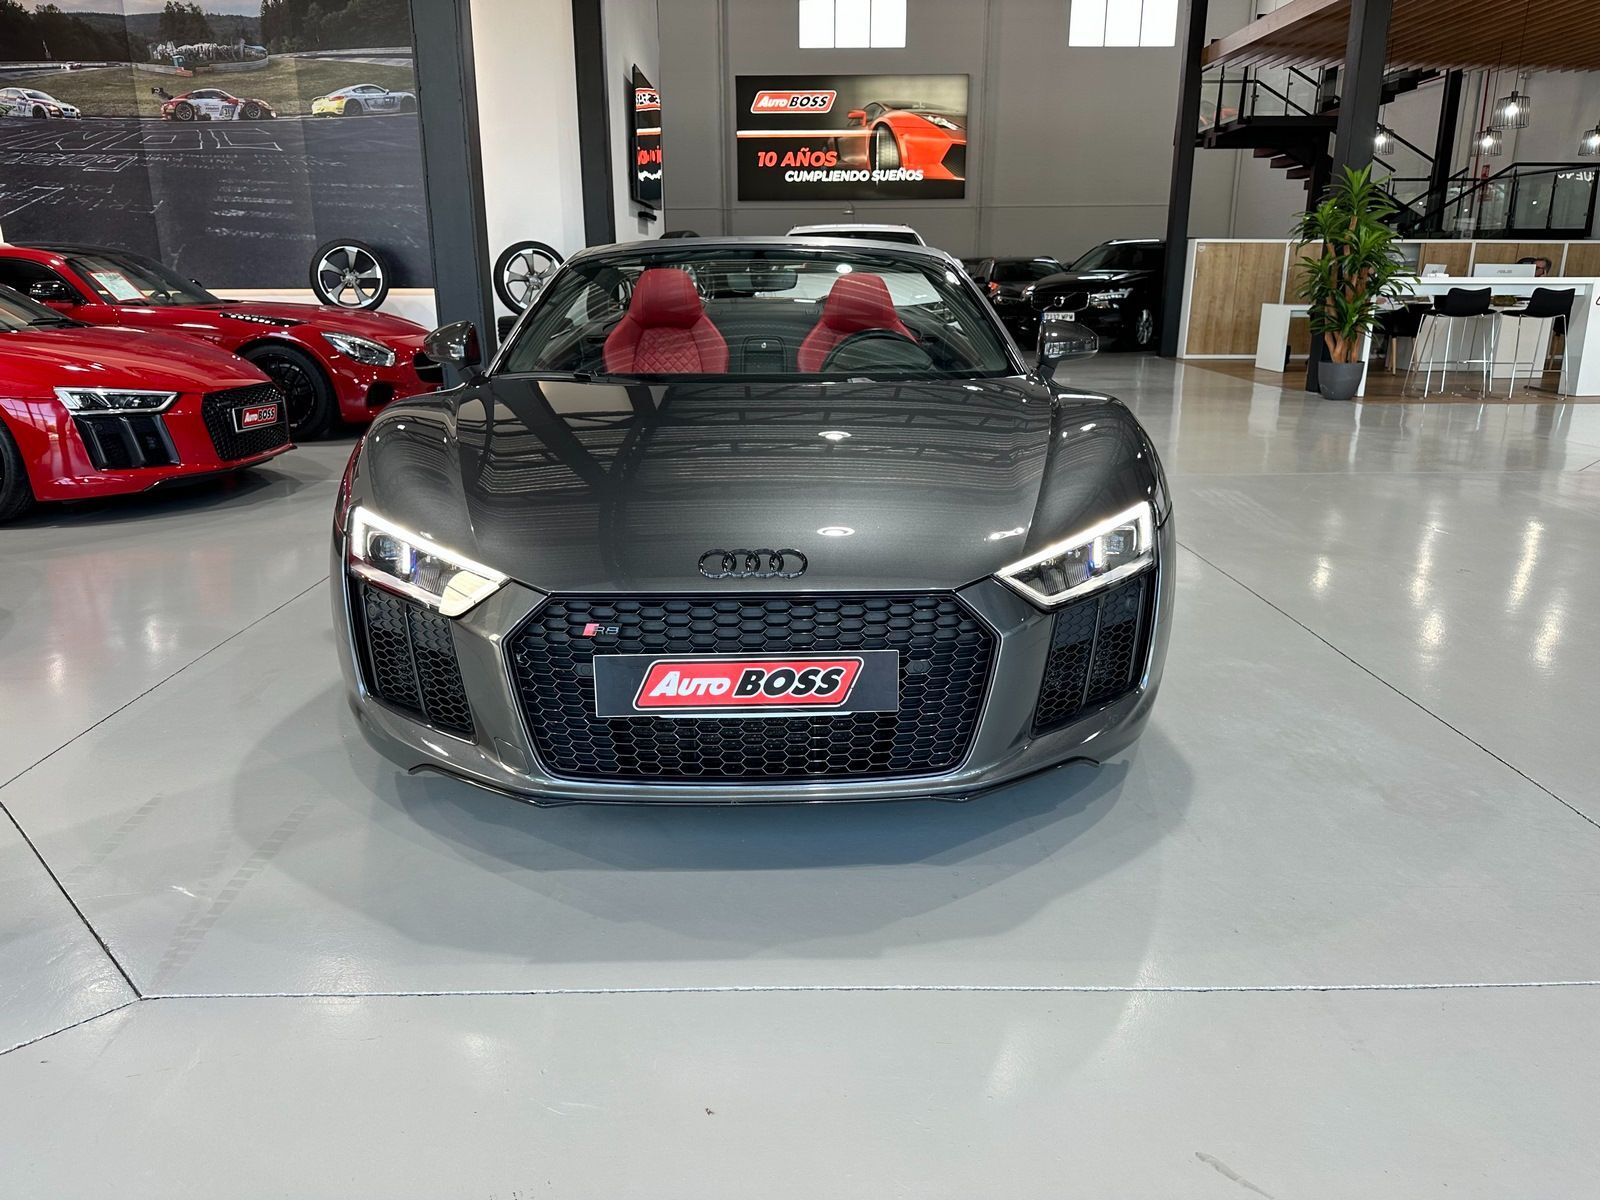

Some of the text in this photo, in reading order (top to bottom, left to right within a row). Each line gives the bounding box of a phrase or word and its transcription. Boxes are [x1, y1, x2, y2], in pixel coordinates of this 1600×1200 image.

[789, 95, 829, 108] BOSS
[757, 147, 838, 168] 10 AÑOS
[784, 167, 924, 183] CUMPLIENDO SUEÑOS
[258, 408, 275, 421] BOSS
[594, 625, 620, 635] R8
[732, 666, 847, 698] BOSS
